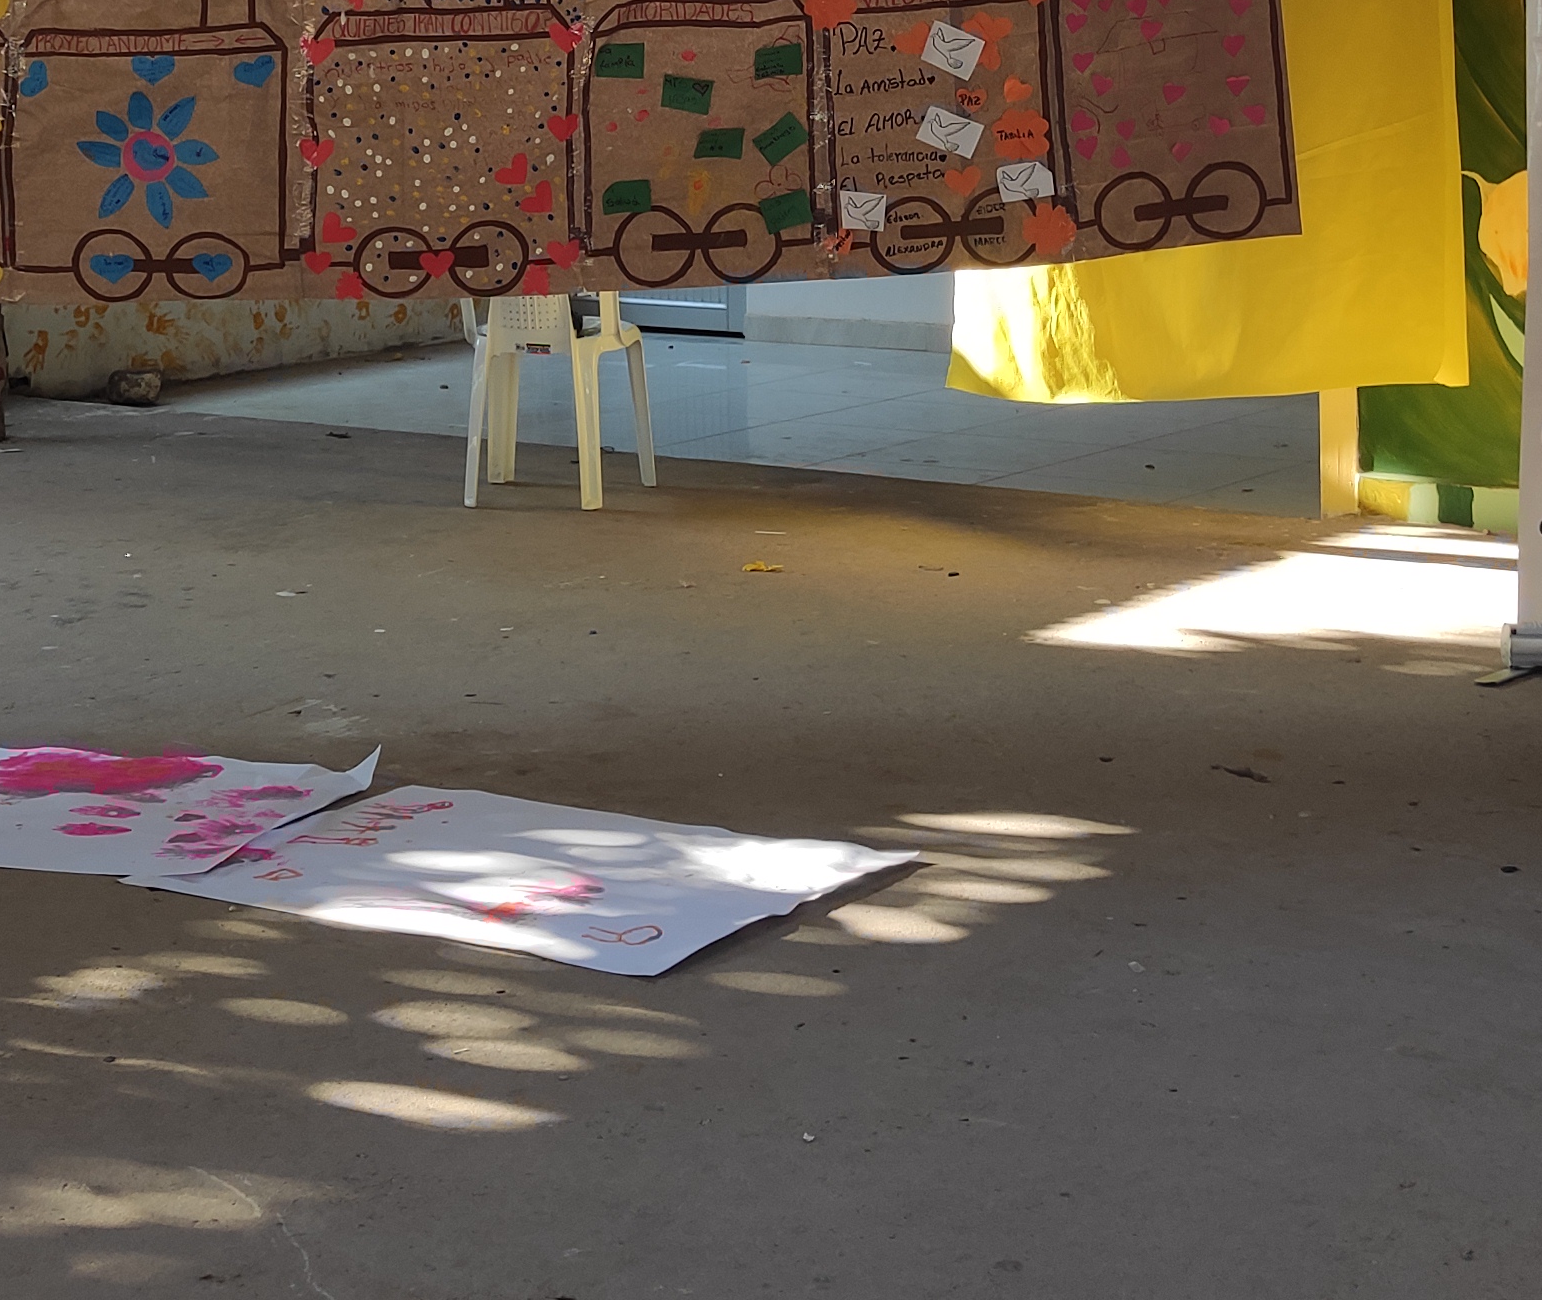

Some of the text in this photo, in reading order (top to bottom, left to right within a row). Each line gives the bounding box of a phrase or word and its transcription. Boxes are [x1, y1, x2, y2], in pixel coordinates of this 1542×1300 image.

[617, 2, 755, 25] PRIORIDADES
[35, 32, 189, 53] PROYECTANDOME
[834, 69, 855, 95] La
[959, 94, 981, 106] PAZ
[840, 147, 860, 167] La
